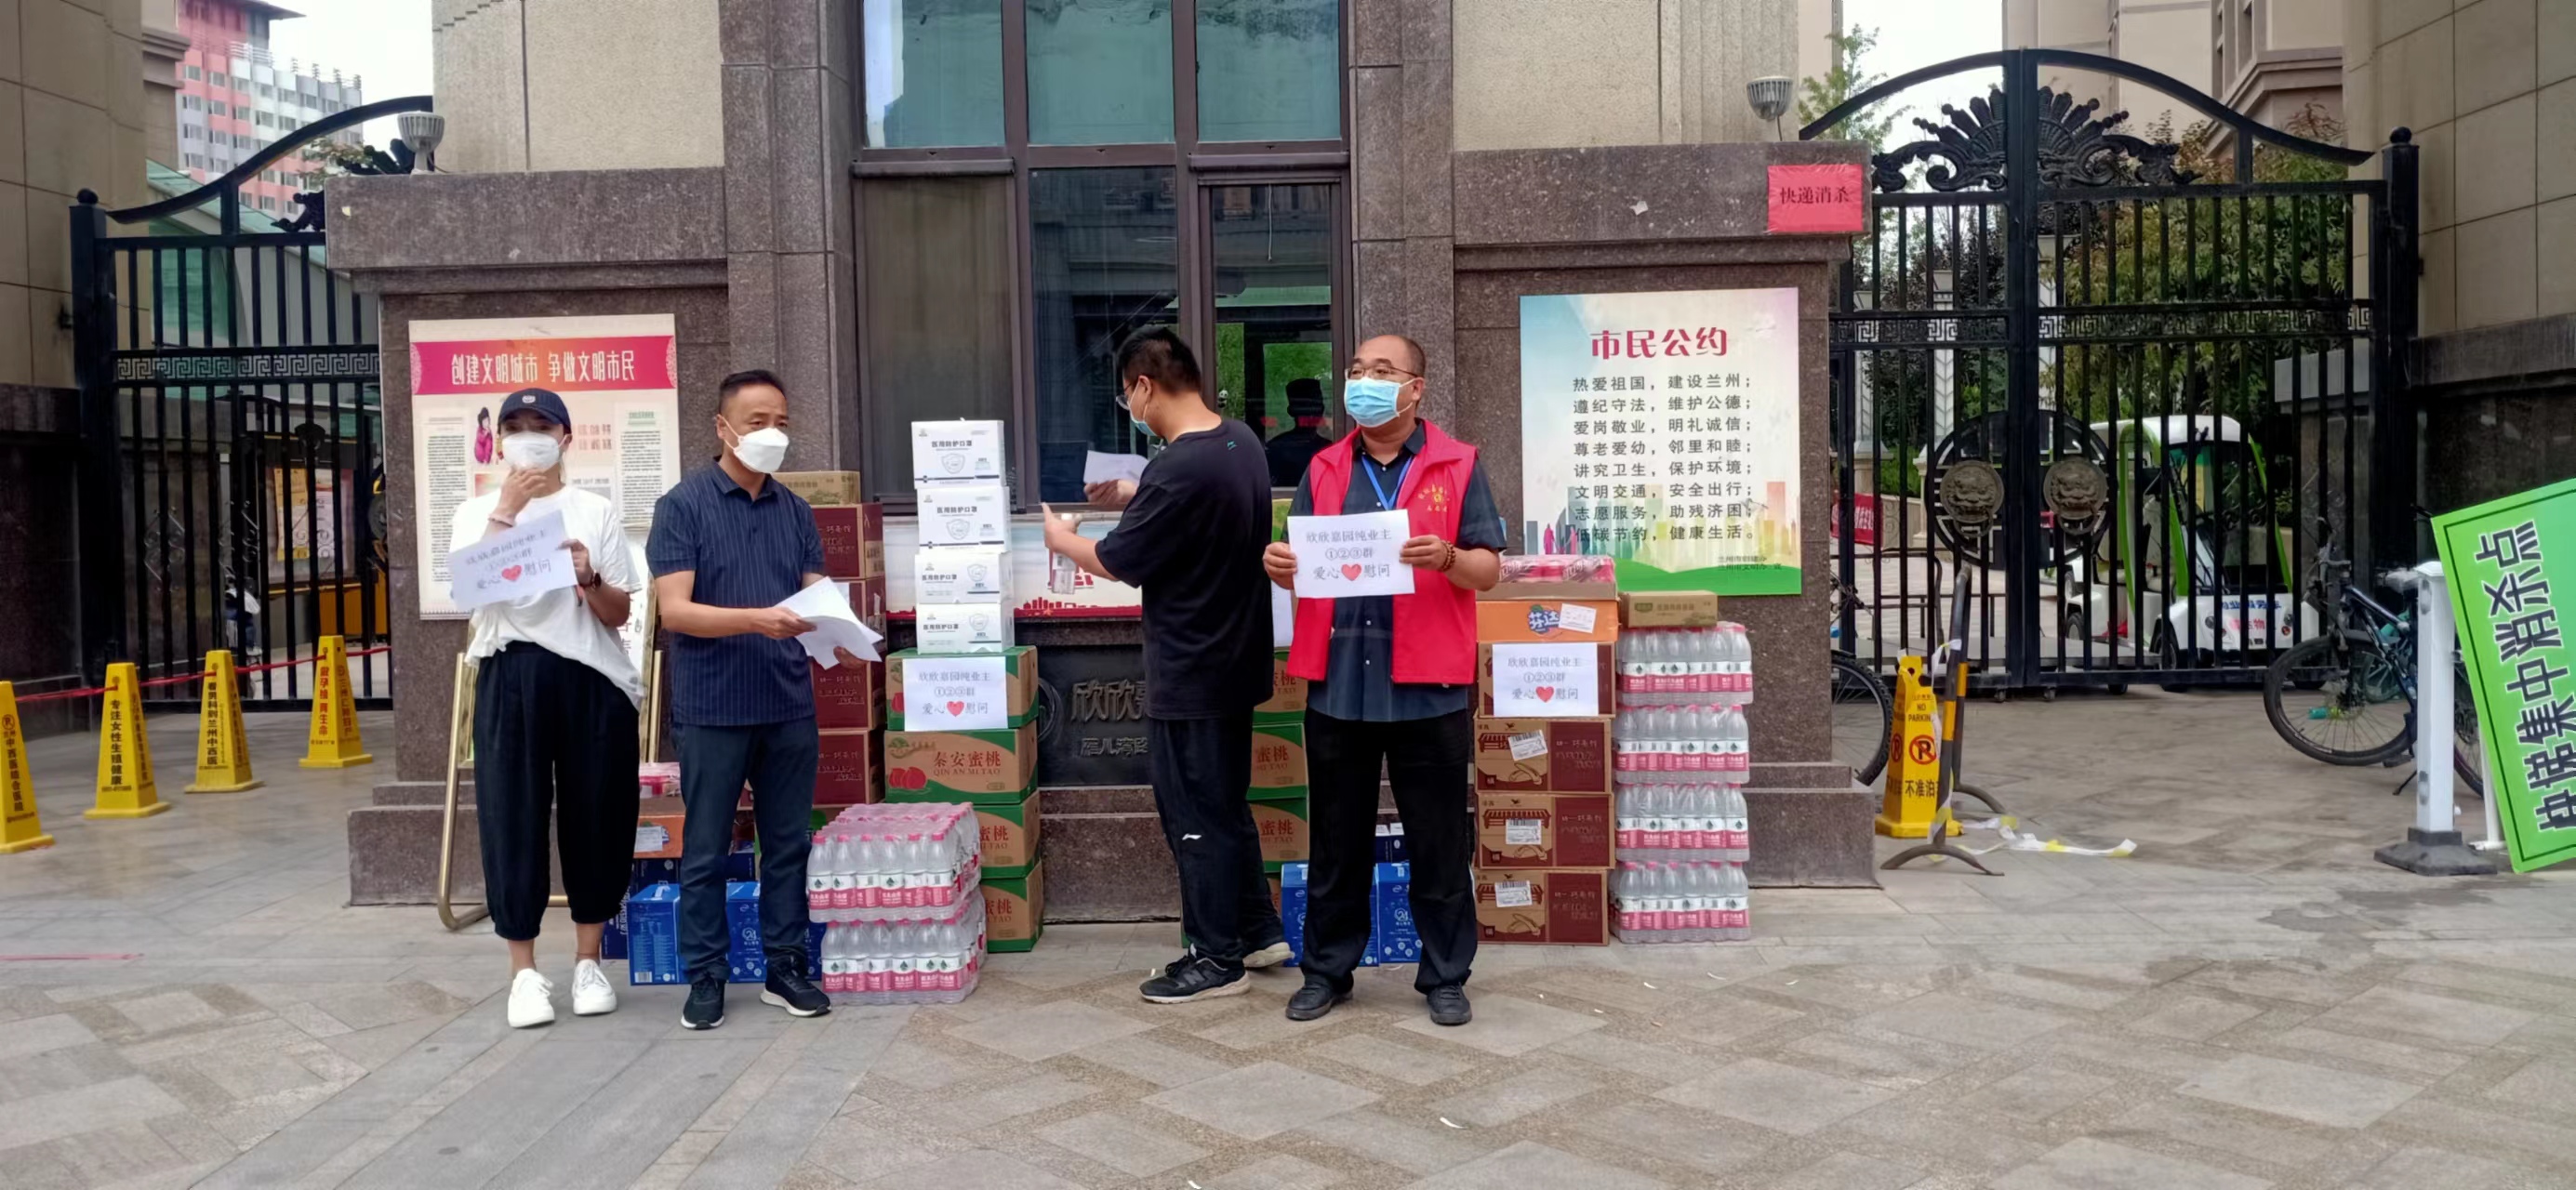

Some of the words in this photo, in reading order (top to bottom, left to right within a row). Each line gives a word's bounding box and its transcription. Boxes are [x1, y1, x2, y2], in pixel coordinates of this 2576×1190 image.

[1780, 187, 1850, 205] 快递消杀
[1590, 327, 1728, 360] 市民公约
[451, 353, 538, 386] 创建文明城市
[548, 350, 636, 384] 争做文明市民
[1917, 703, 1927, 711] NO
[933, 750, 1002, 768] 秦安蜜桃
[1905, 779, 1938, 799] 不准泊
